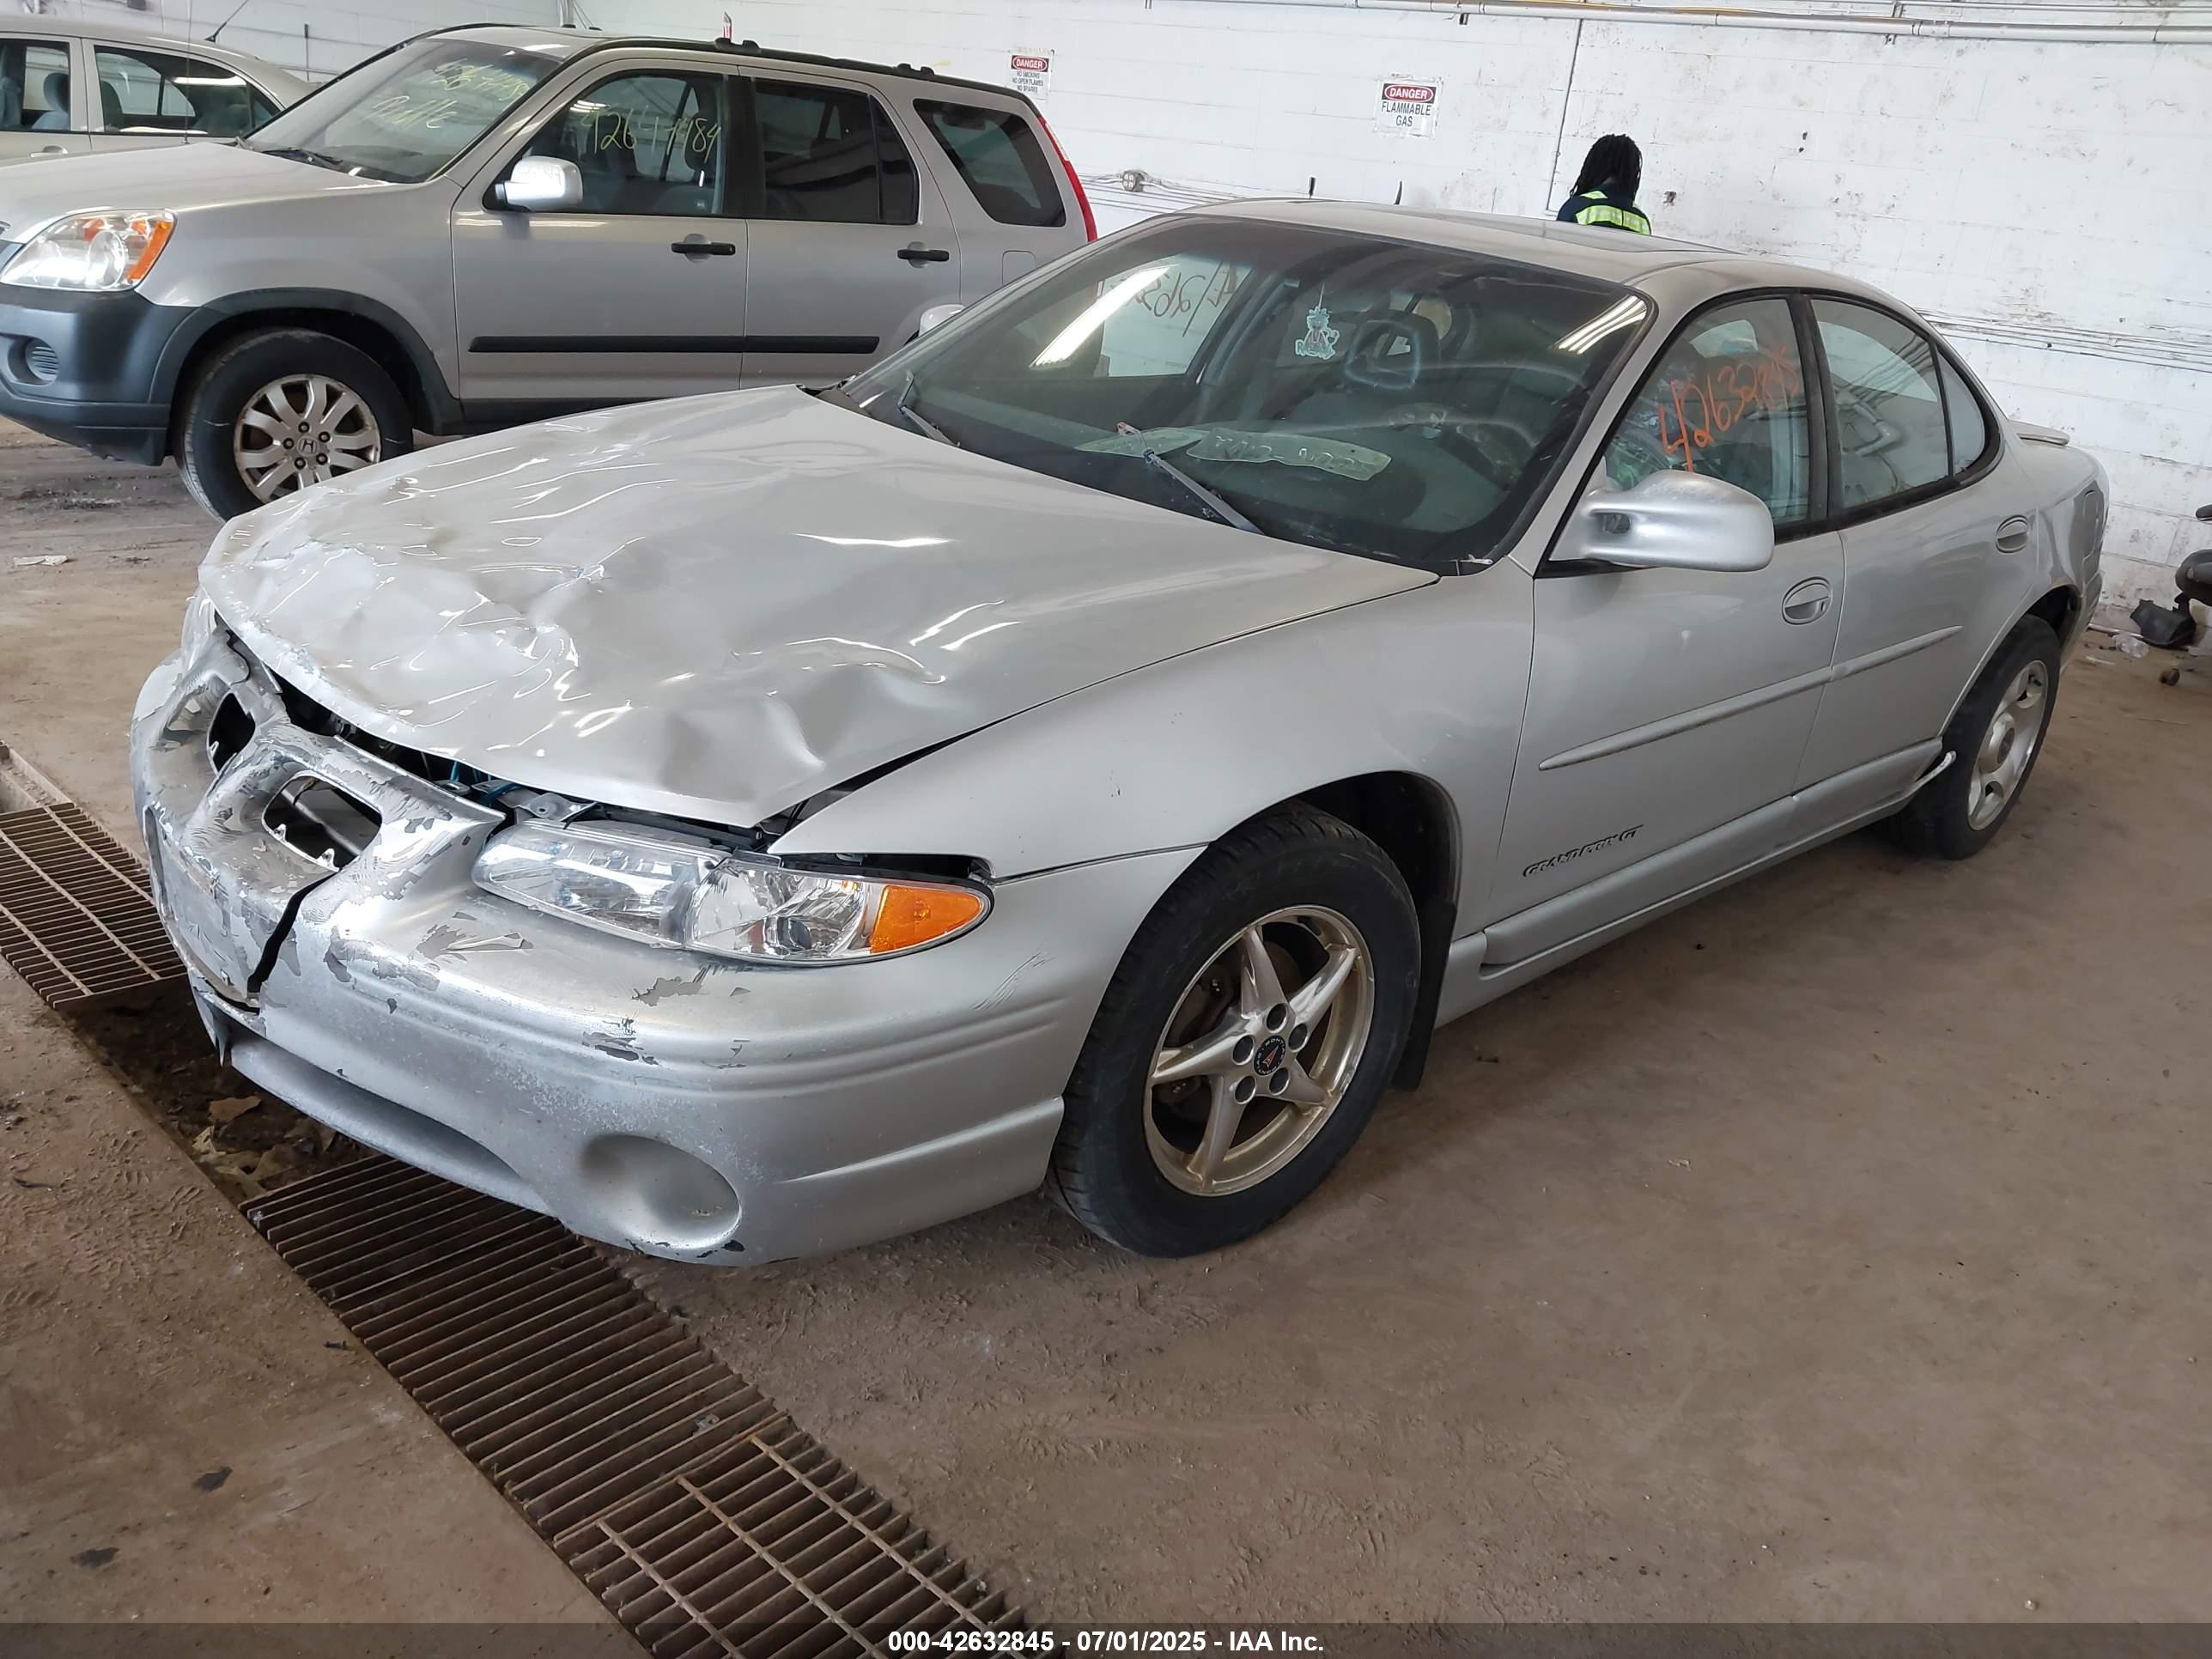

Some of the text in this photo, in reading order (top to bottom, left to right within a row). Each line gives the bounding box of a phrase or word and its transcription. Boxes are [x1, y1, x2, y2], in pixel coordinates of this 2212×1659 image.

[1015, 58, 1043, 69] DANGER
[1389, 87, 1428, 100] DANGER
[1381, 100, 1432, 116] FLAMMABLE
[1395, 114, 1413, 127] GAS
